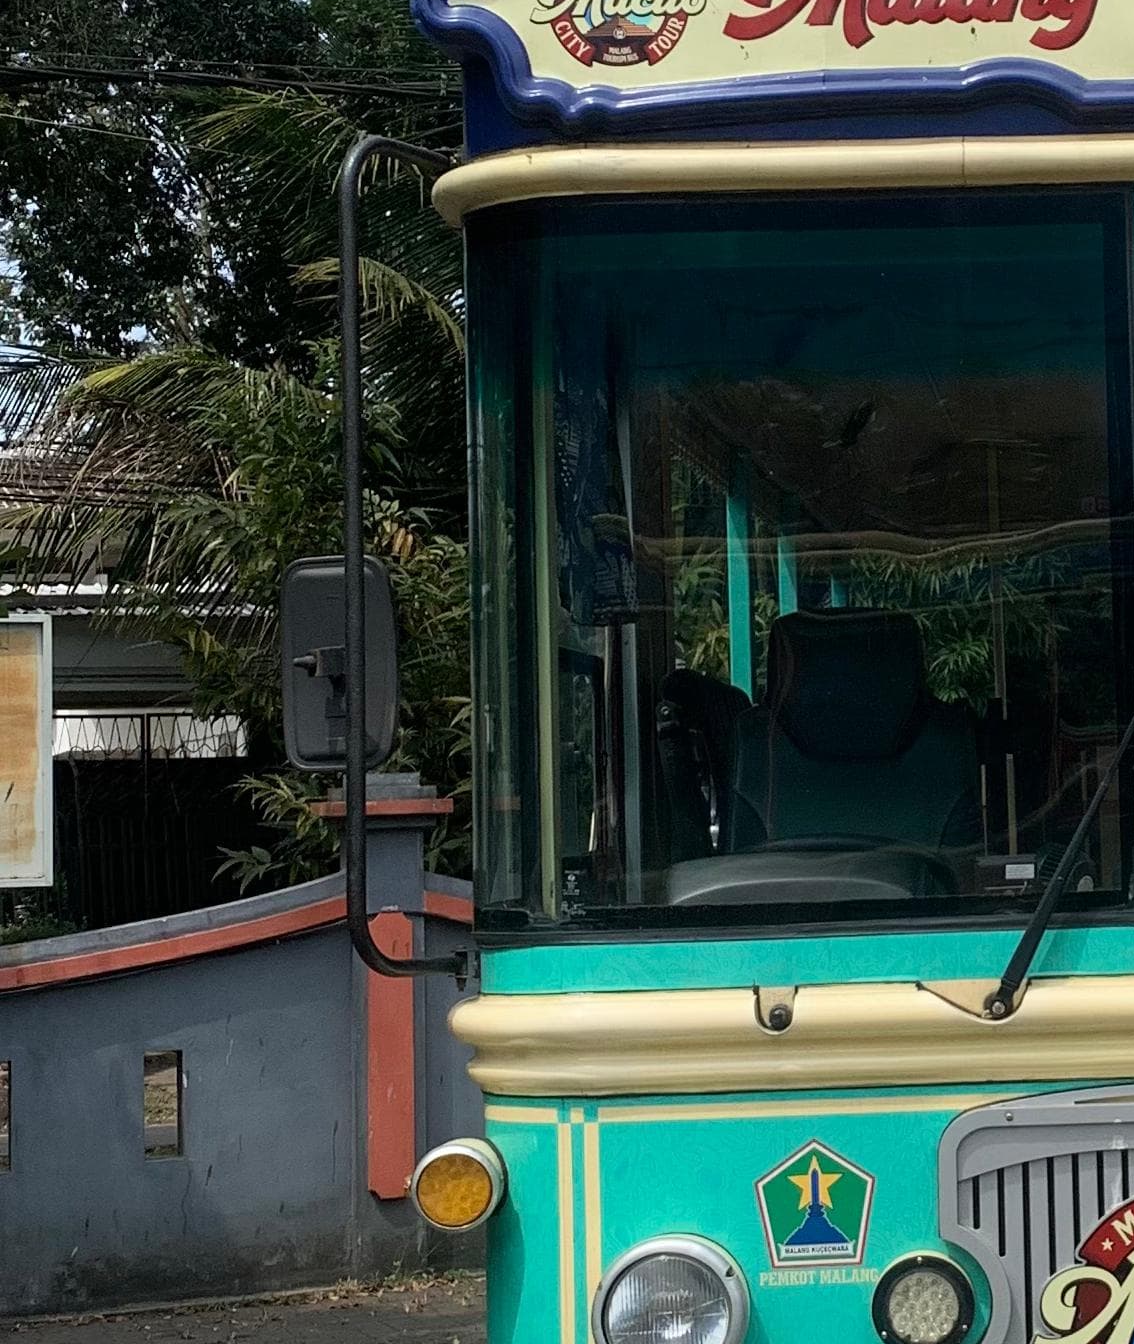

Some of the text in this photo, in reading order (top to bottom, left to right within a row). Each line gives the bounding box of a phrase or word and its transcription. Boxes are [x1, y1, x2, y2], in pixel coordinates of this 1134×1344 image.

[555, 20, 591, 58] CITY
[648, 16, 686, 58] TOUR
[759, 1267, 880, 1287] PEMKOT MALANG
